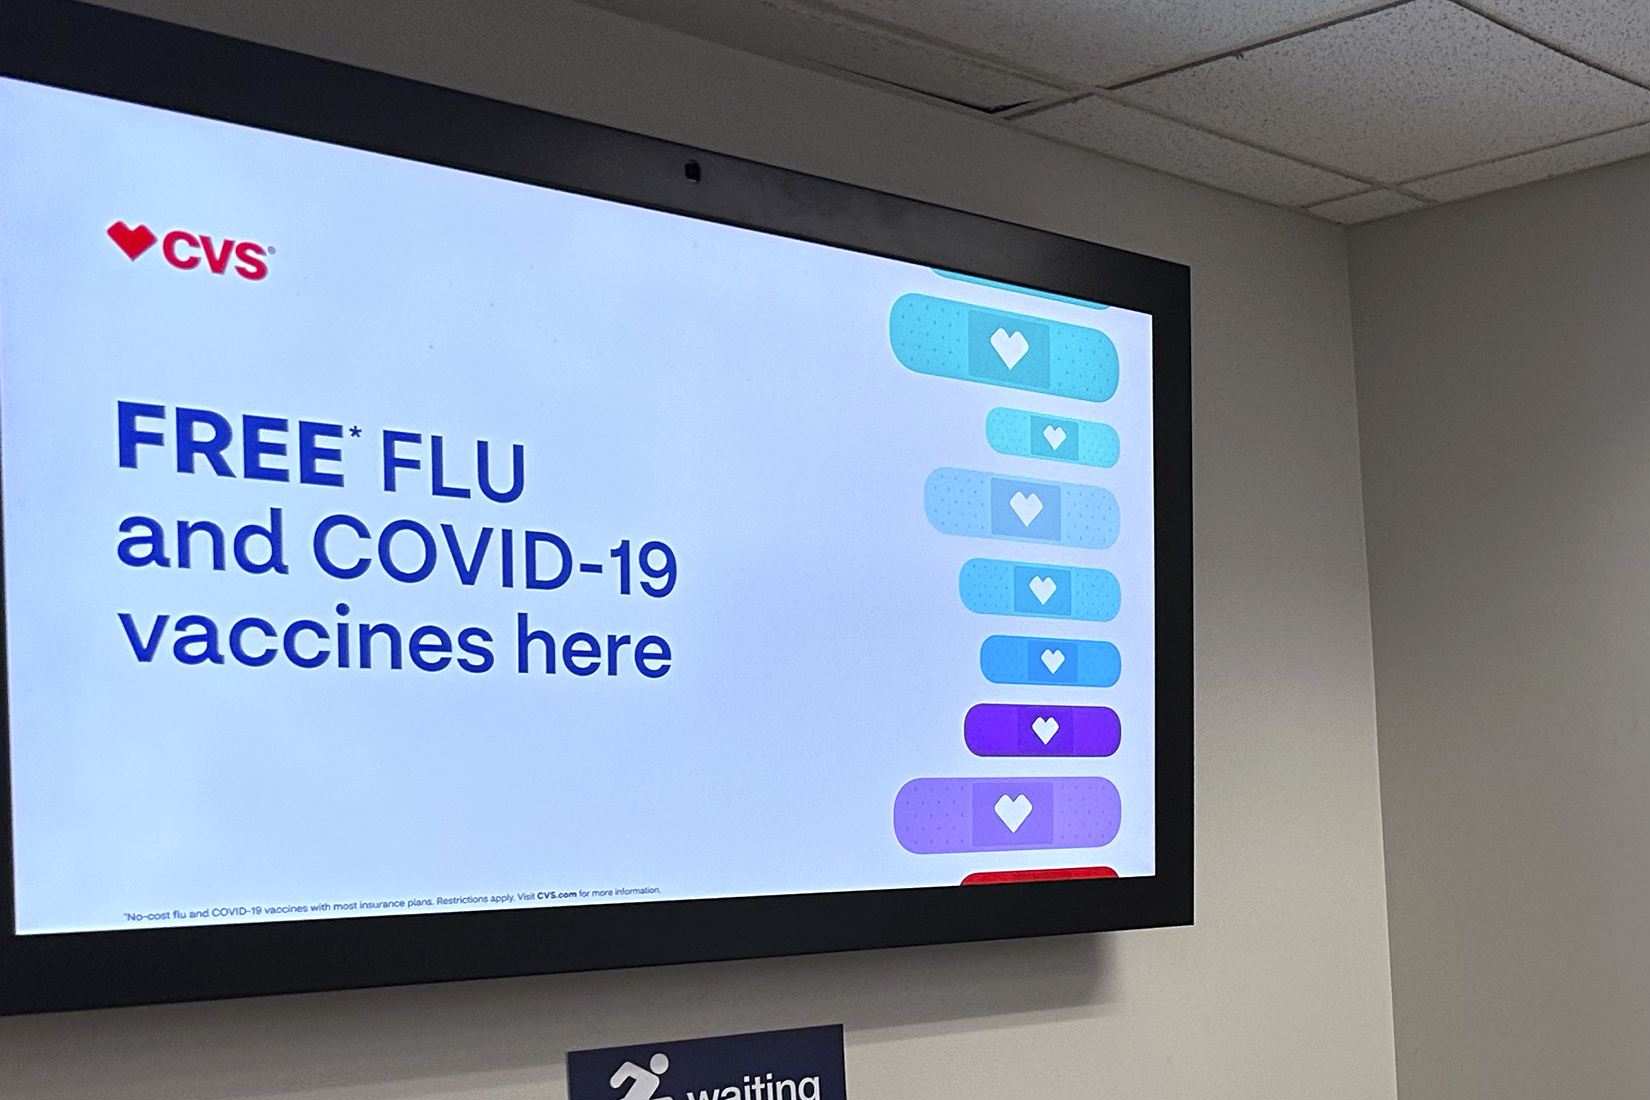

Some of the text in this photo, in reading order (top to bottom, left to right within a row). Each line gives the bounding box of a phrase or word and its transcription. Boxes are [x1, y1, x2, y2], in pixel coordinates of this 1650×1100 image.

[161, 229, 269, 281] CVS
[381, 429, 526, 503] FLU
[116, 506, 678, 599] and COVID-19
[117, 602, 674, 679] vaccines here
[173, 909, 187, 919] flu
[189, 908, 210, 918] and
[212, 906, 263, 917] COVID-19
[264, 903, 309, 915] vaccines
[310, 901, 331, 912] with
[333, 900, 358, 911] most
[359, 899, 406, 910] insurance
[407, 897, 434, 908] plans.
[436, 894, 489, 906] Restrictions
[490, 893, 516, 905] apply.
[517, 891, 536, 902] Visit
[536, 890, 577, 900] CVS.com
[578, 889, 591, 898] for
[592, 888, 614, 898] more
[615, 885, 662, 896] information.
